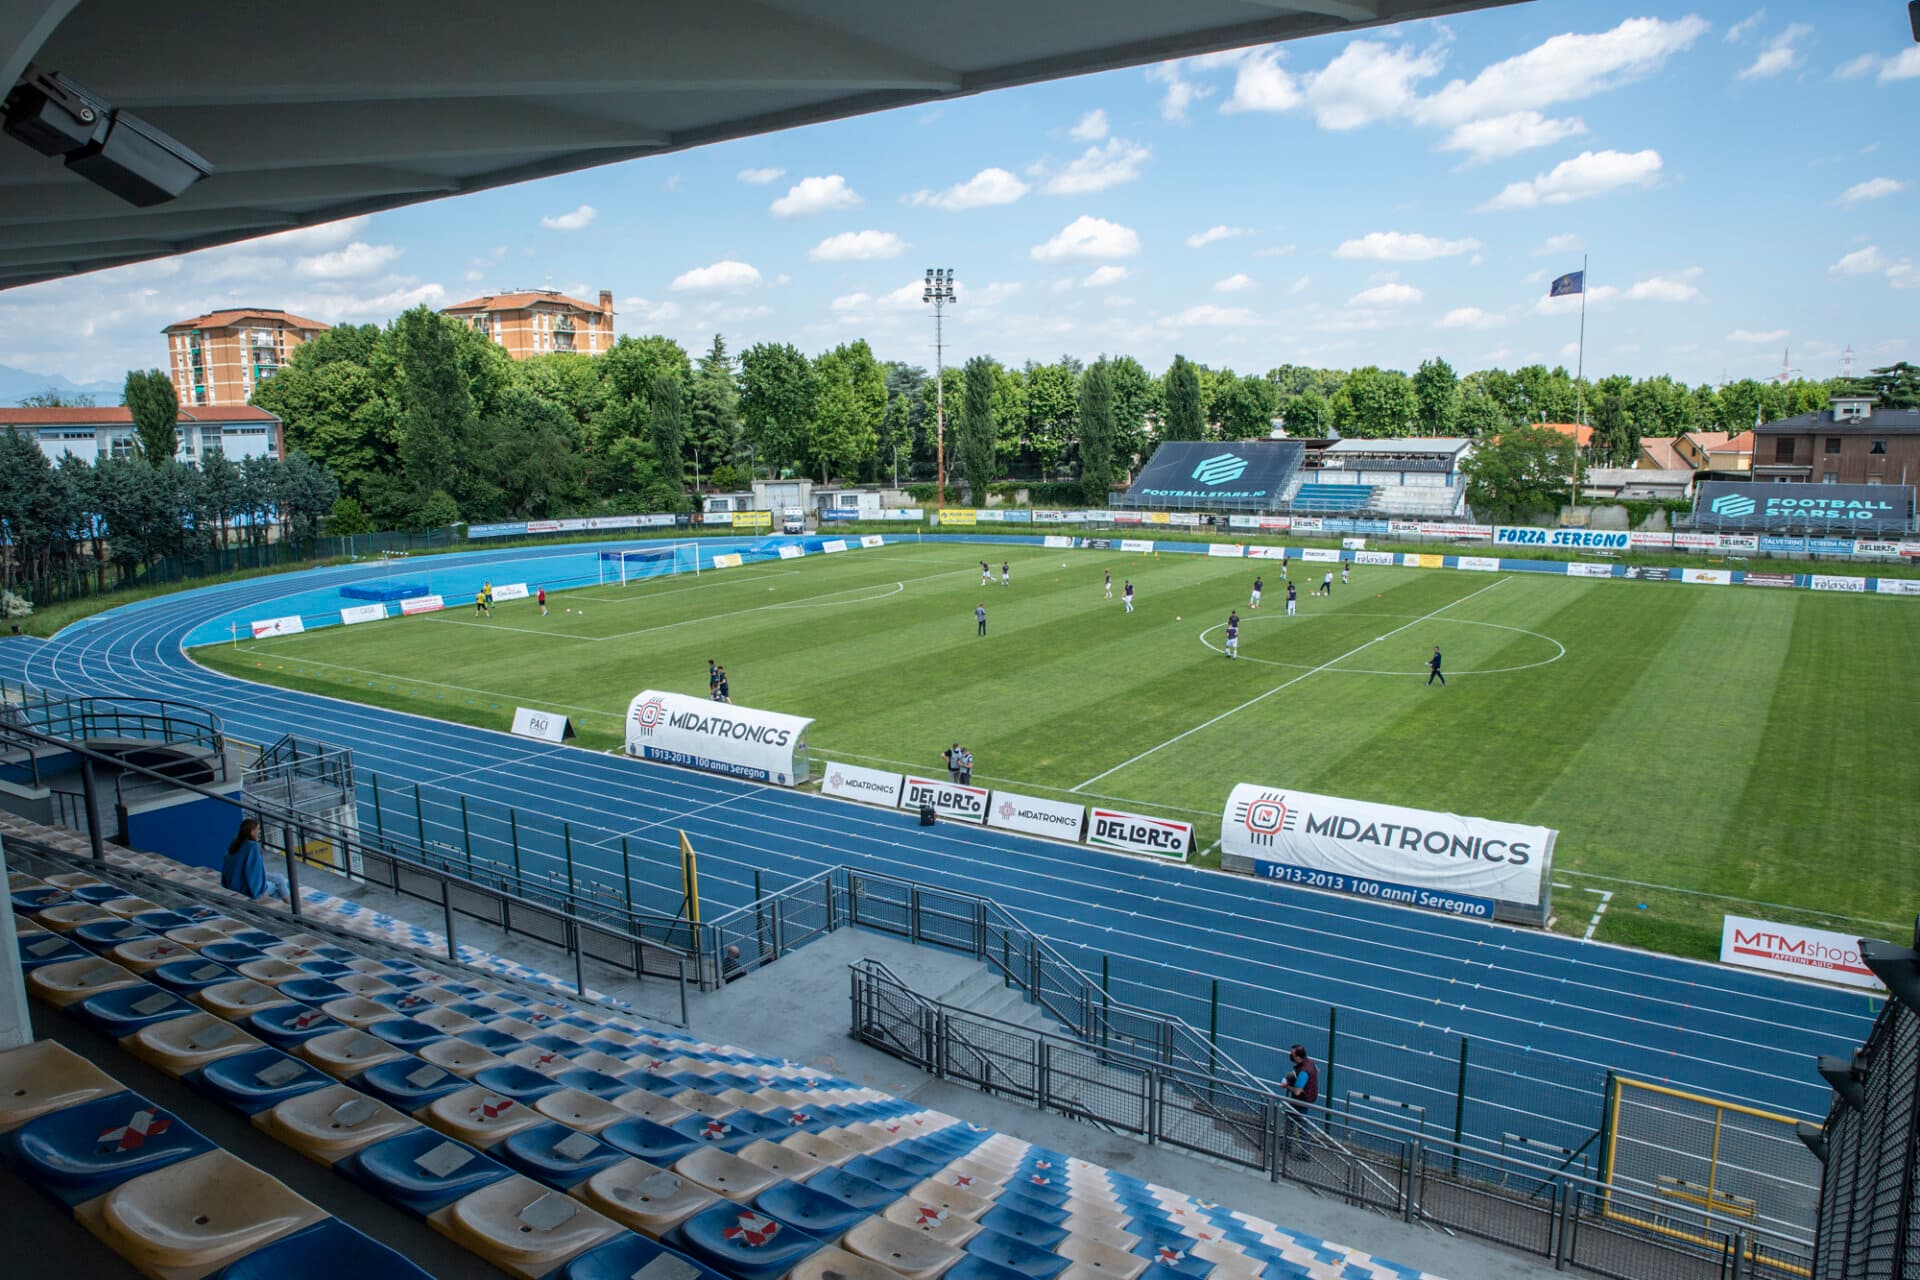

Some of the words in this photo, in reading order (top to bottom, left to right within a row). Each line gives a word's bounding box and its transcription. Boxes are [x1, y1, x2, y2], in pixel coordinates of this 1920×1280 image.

[1141, 488, 1267, 498] FOOTBALLSTARS.IO
[1766, 498, 1893, 510] FOOTBALL
[1765, 508, 1874, 520] STARS.IO
[1498, 528, 1546, 544] FORZA
[1552, 531, 1628, 548] SEREGNO
[530, 718, 549, 731] PACI
[669, 711, 791, 747] MIDATRONICS
[650, 748, 691, 764] 1913-2013
[695, 756, 710, 769] 100
[710, 760, 729, 772] anni
[730, 765, 766, 779] Seregno
[845, 779, 894, 794] MIDATRONICS
[1018, 810, 1077, 827] MIDATRONICS
[1305, 811, 1531, 866] MIDATRONICS
[1267, 865, 1343, 890] 1913-2013
[1351, 879, 1379, 896] 100
[1381, 888, 1417, 904] anni
[1418, 891, 1486, 917] Seregno
[1811, 960, 1834, 970] AUTO
